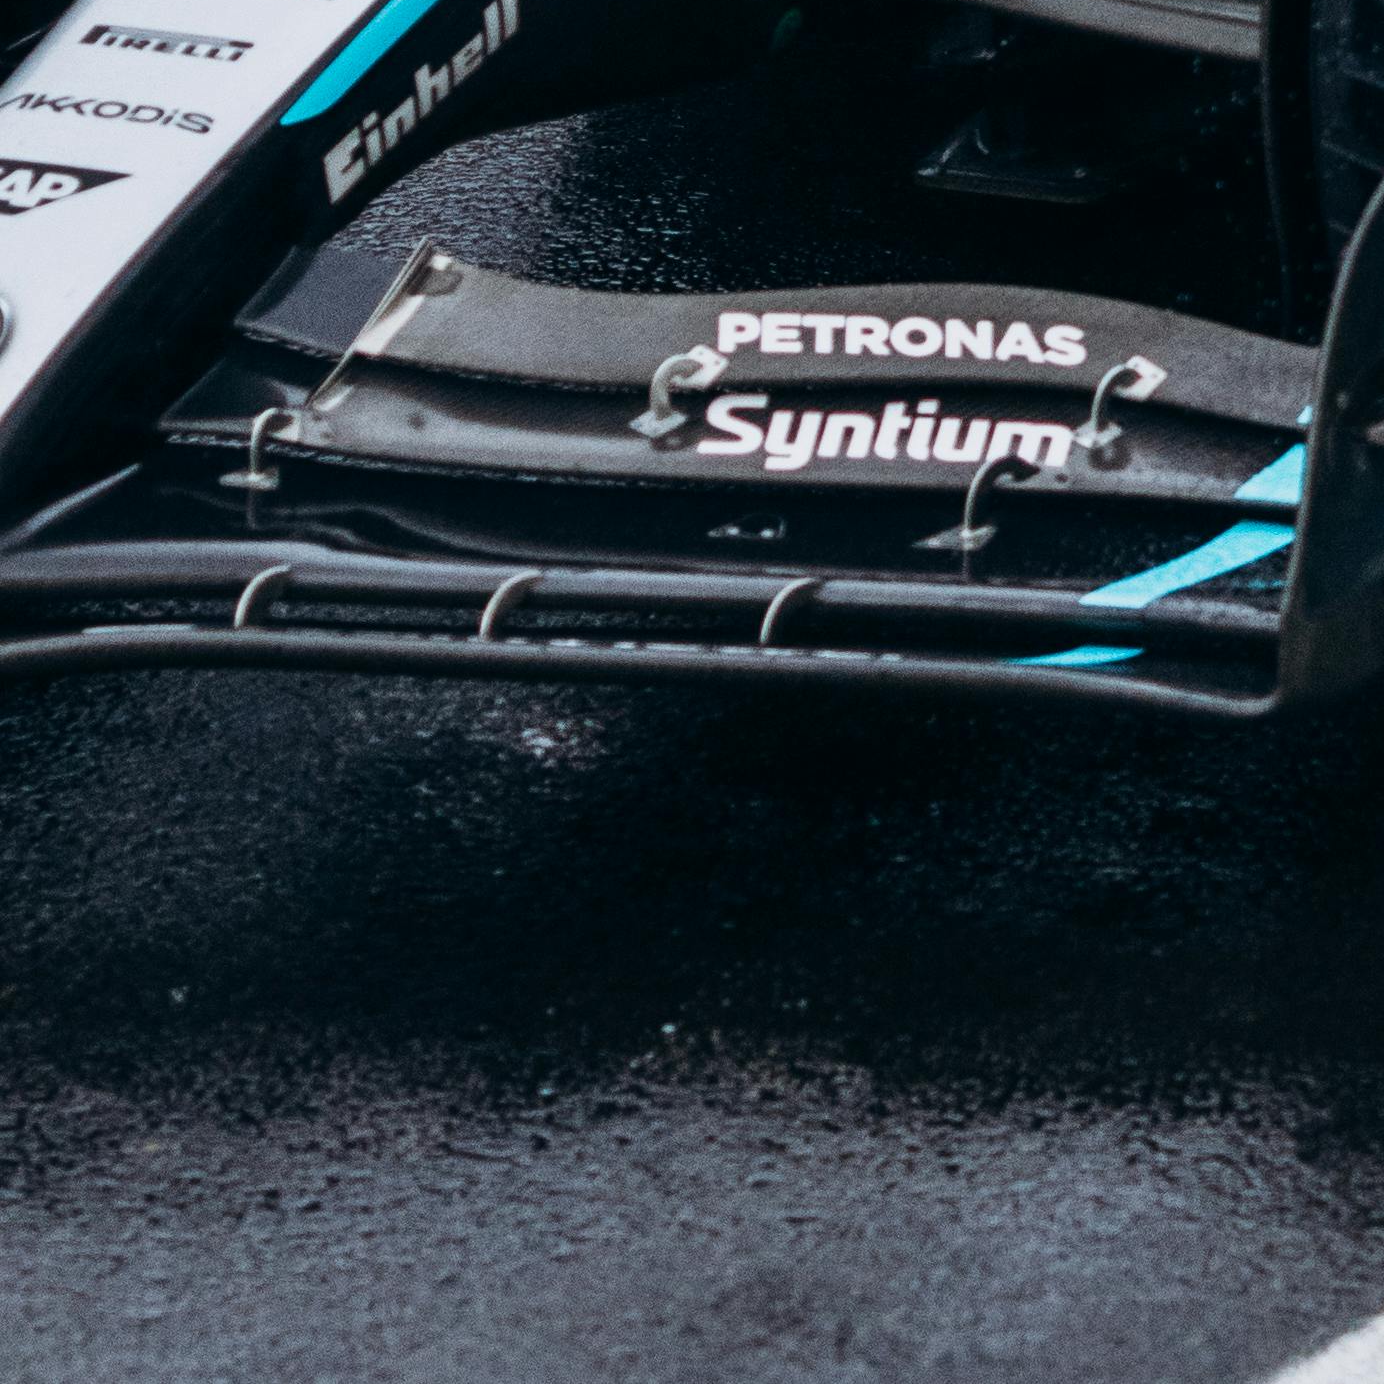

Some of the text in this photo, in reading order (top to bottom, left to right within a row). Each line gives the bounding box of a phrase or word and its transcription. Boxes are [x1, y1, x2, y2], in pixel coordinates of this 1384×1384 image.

[78, 23, 254, 63] PIRELLI
[0, 165, 81, 209] AP
[717, 312, 1088, 366] PETRONAS
[697, 393, 1074, 471] Syntium
